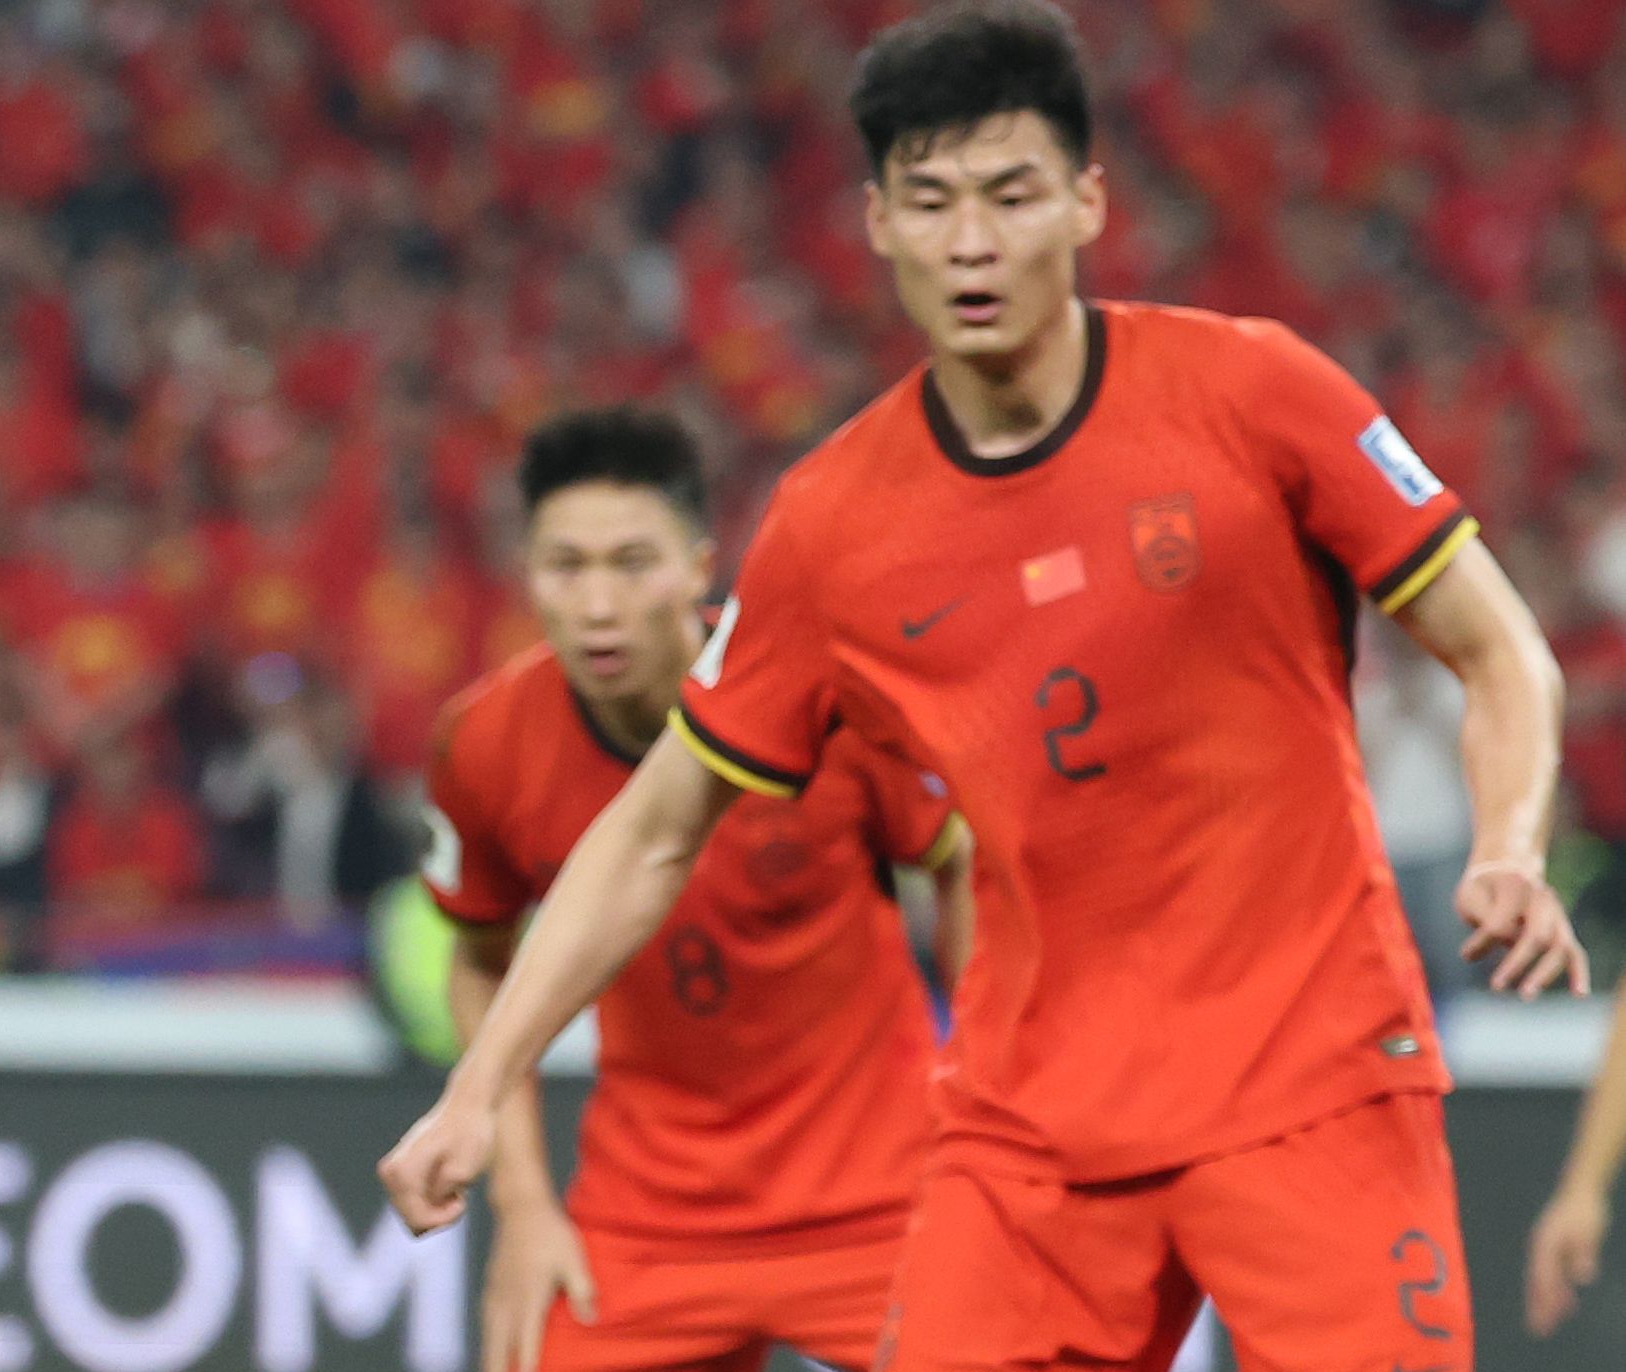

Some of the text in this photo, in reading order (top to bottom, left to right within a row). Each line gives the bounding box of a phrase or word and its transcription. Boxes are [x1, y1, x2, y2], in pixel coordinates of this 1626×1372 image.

[1034, 666, 1106, 781] 2
[666, 925, 730, 1017] 8
[1391, 1230, 1450, 1339] 2
